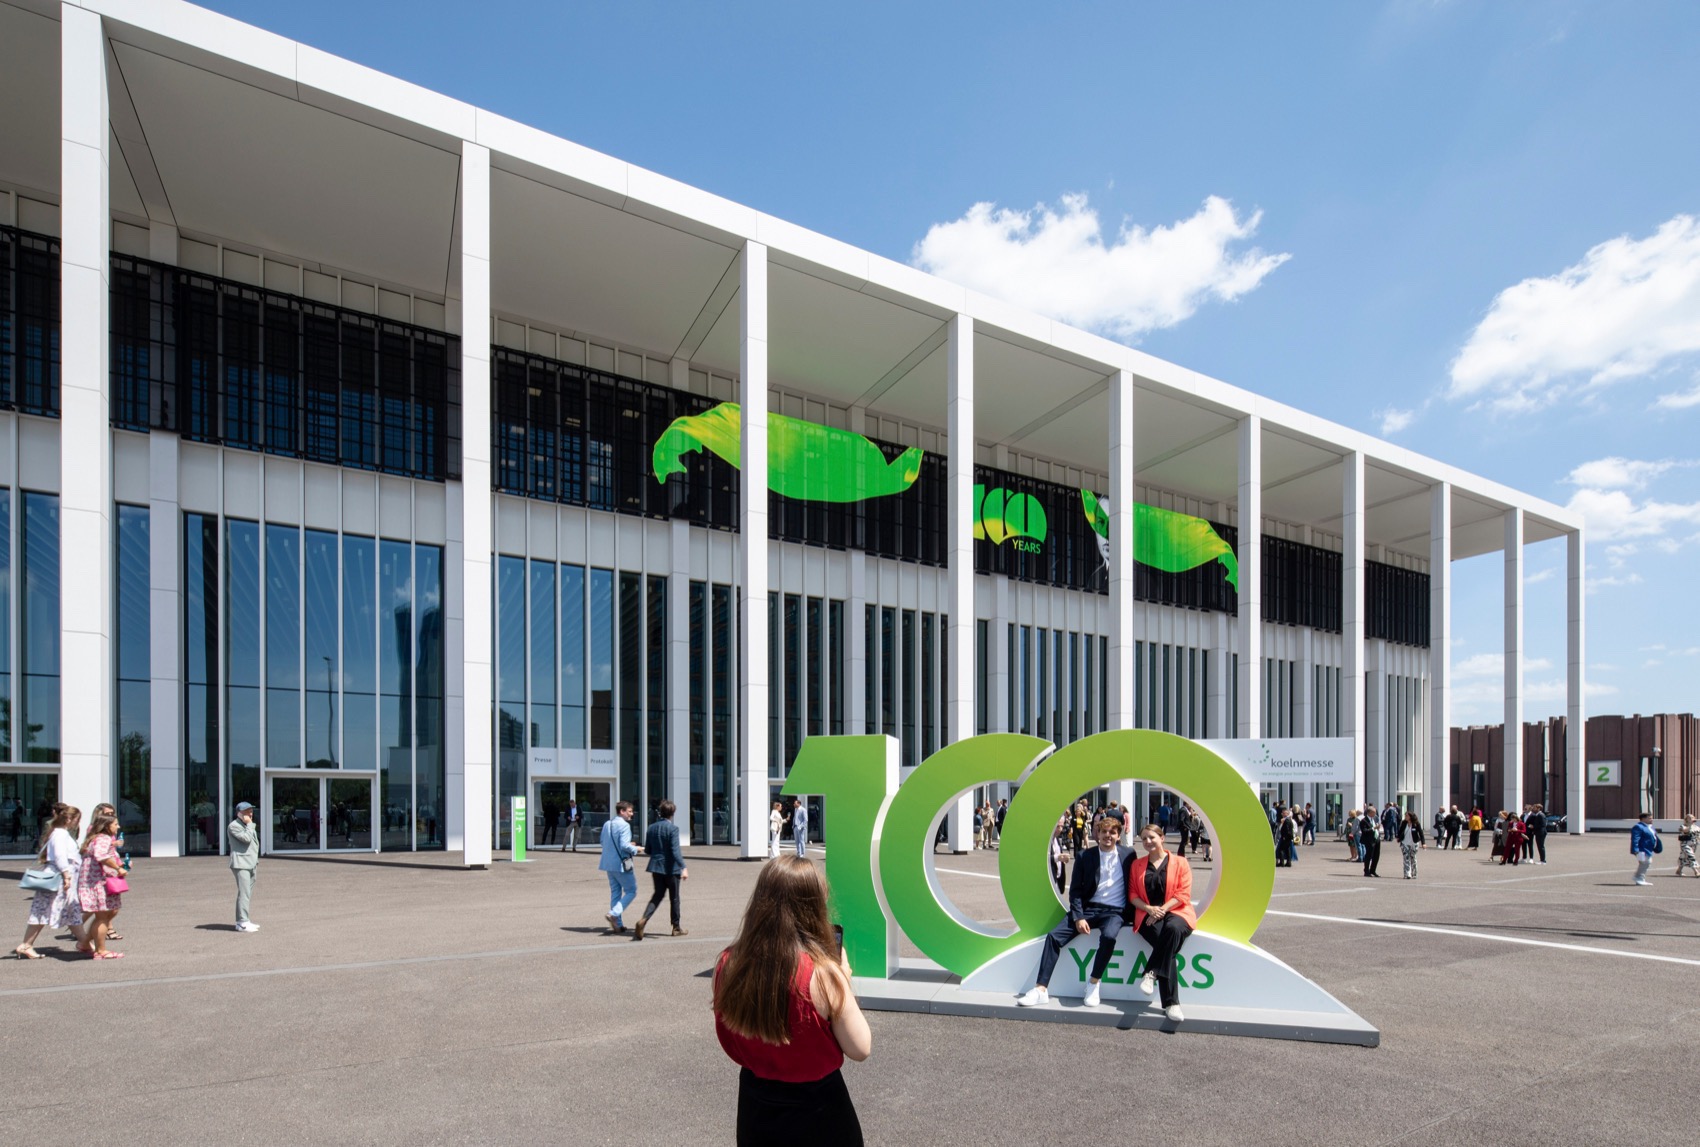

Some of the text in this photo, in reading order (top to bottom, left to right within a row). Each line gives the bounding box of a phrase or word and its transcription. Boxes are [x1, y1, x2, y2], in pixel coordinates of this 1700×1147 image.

[1012, 538, 1041, 554] YEARS
[1271, 758, 1334, 768] koelnmesse
[1597, 766, 1610, 783] 2
[780, 728, 1275, 978] 100
